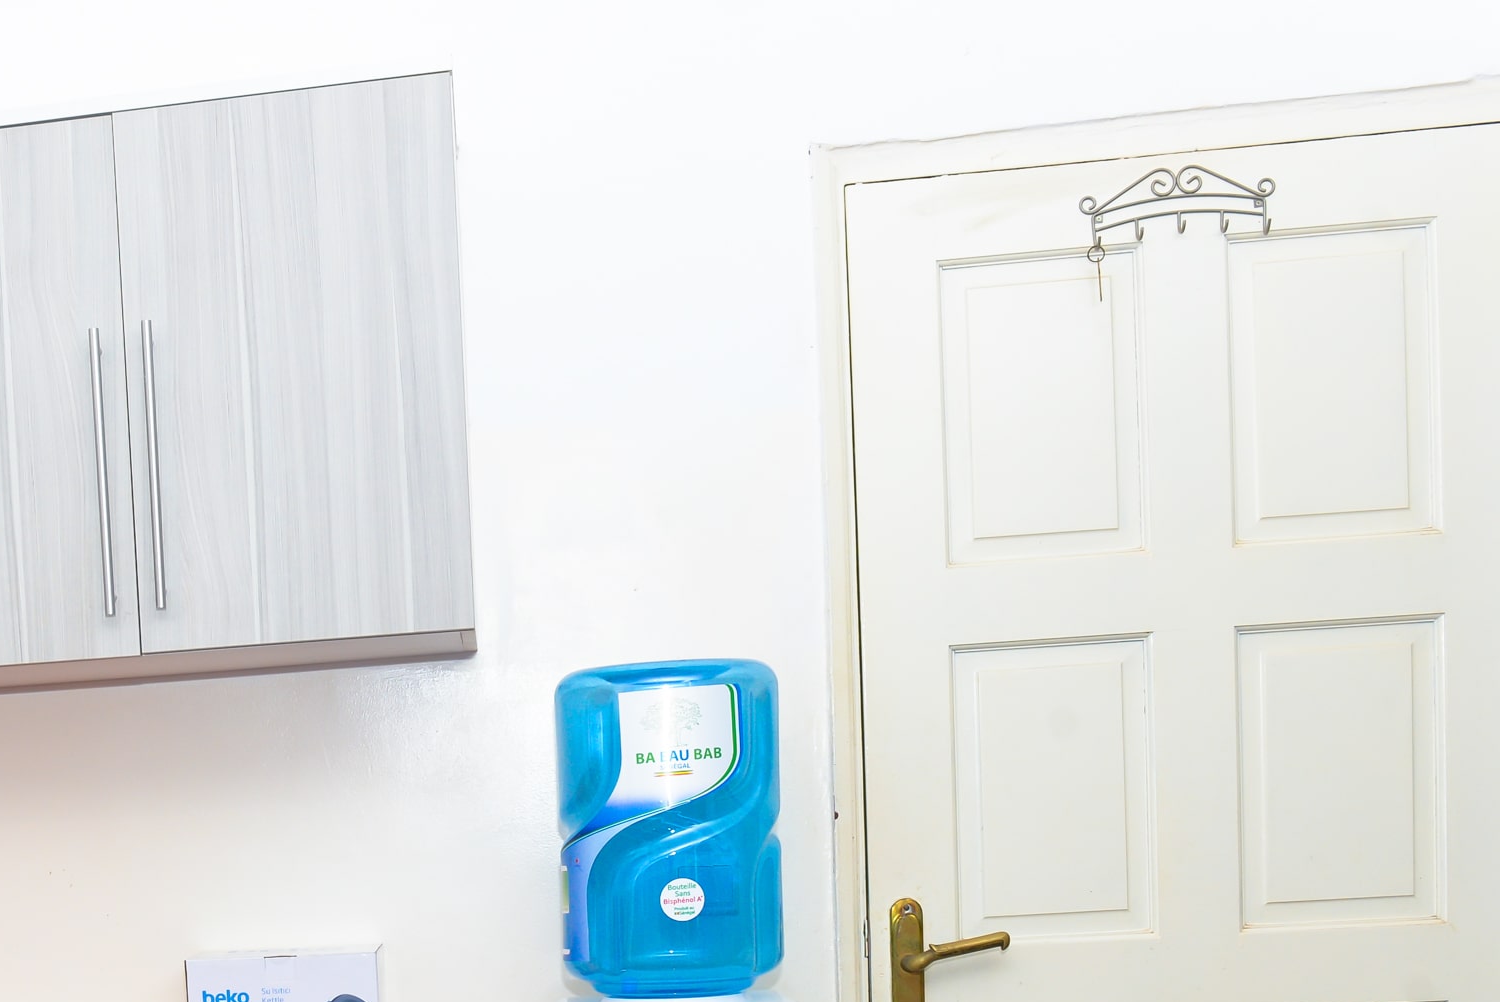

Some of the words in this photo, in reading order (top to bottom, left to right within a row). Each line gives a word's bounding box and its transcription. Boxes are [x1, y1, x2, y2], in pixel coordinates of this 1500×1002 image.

[635, 752, 656, 765] BA
[693, 747, 722, 760] BAB
[667, 882, 697, 891] Bouteille
[663, 896, 696, 906] Bisphénol
